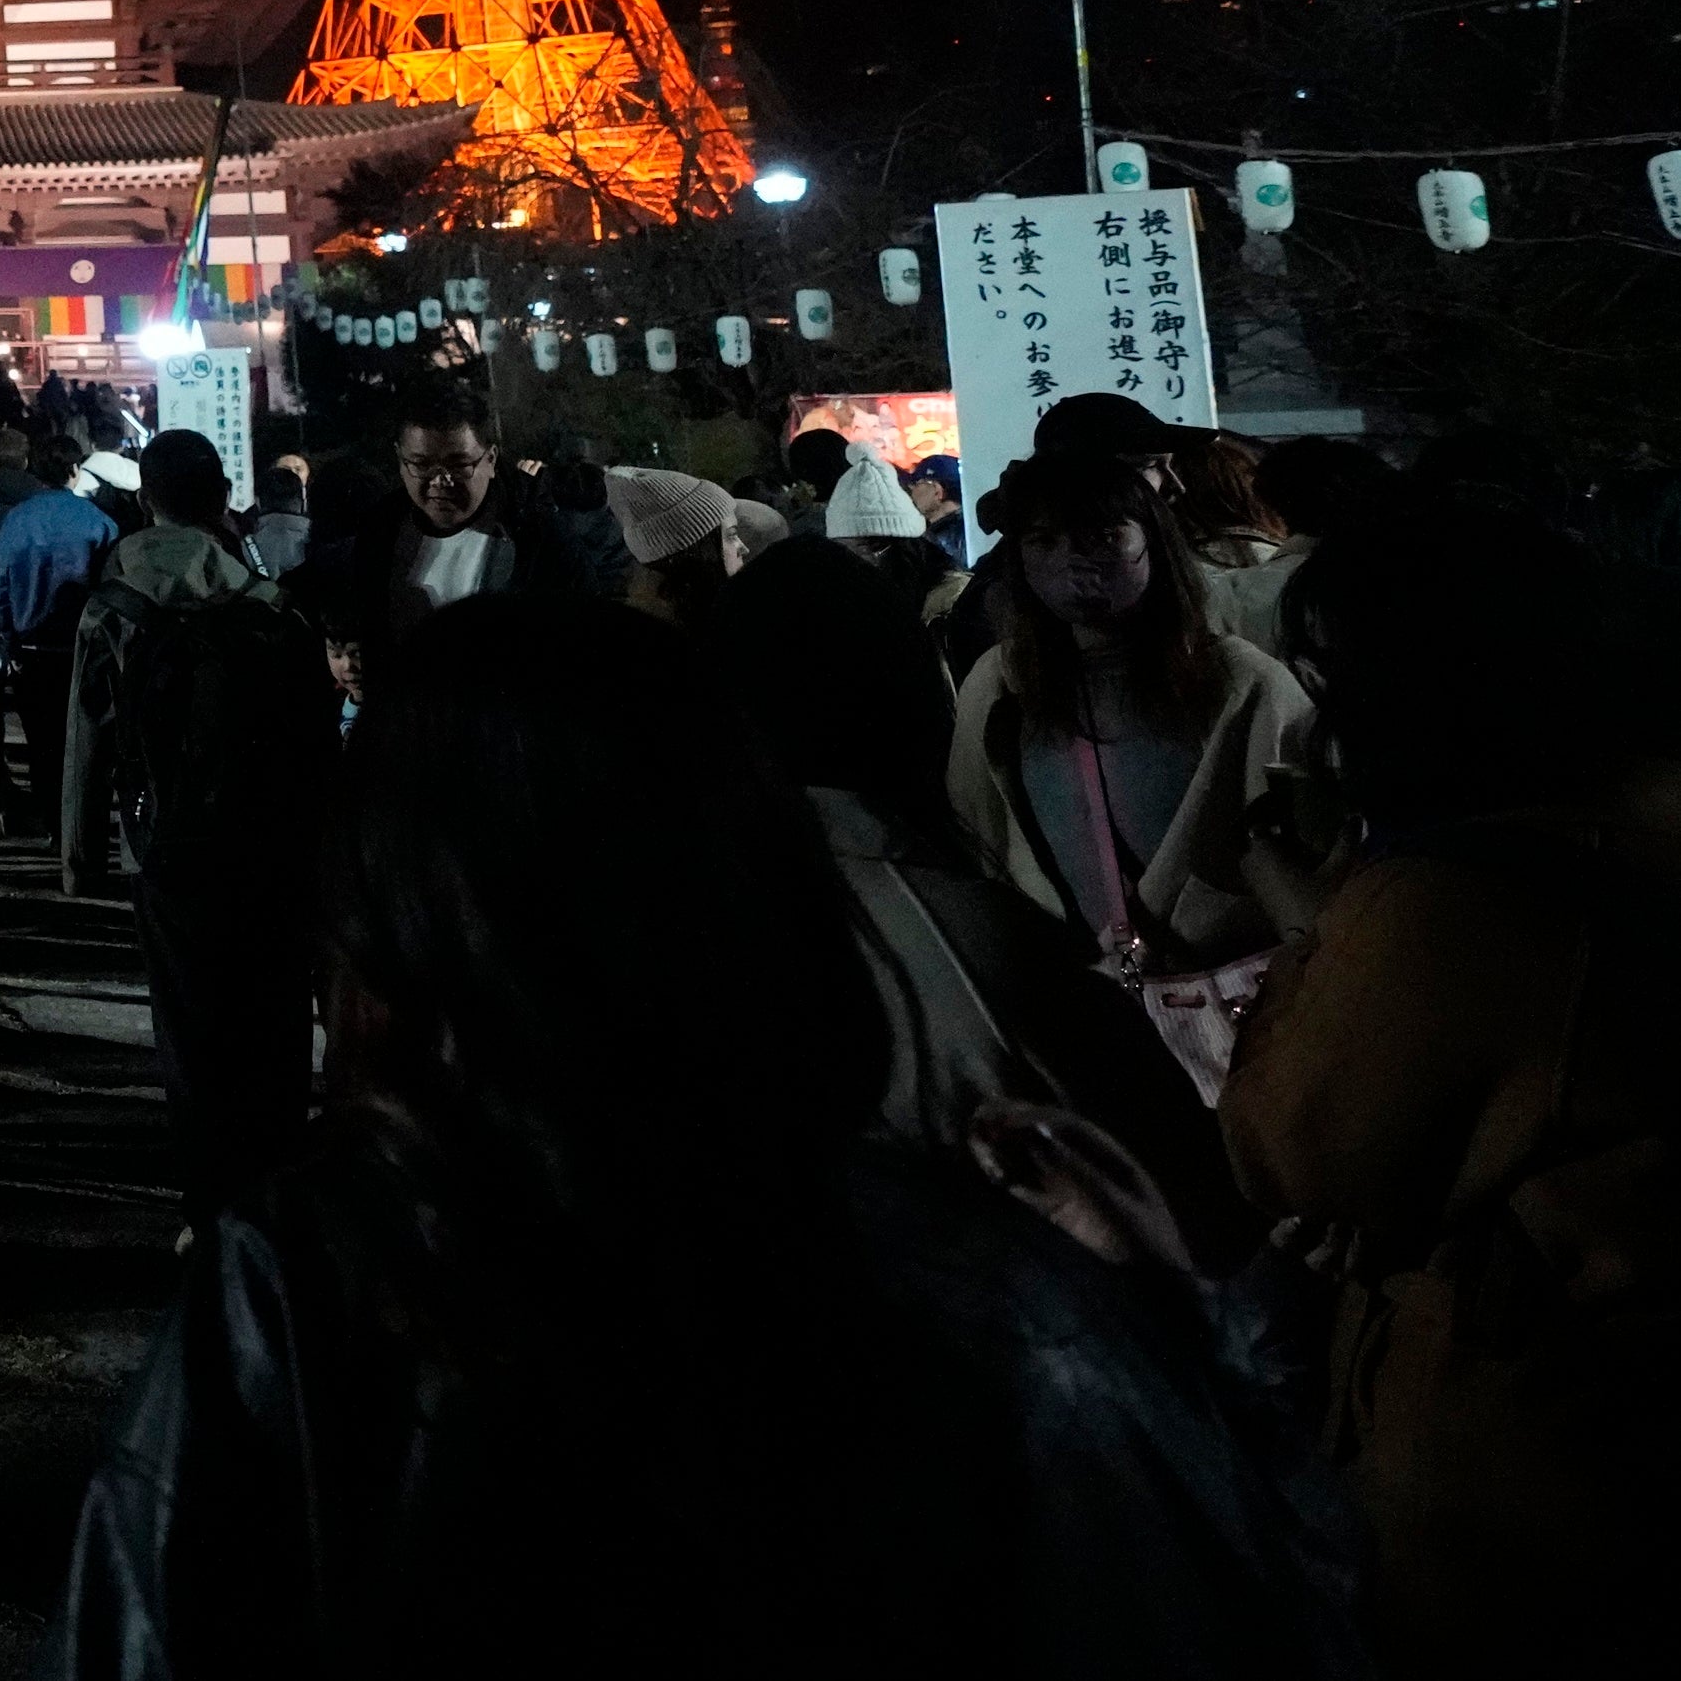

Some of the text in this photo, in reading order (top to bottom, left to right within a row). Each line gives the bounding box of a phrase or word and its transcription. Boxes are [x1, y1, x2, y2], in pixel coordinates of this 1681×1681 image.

[973, 222, 1007, 319] ださい。
[1094, 211, 1143, 391] 右側にお進み
